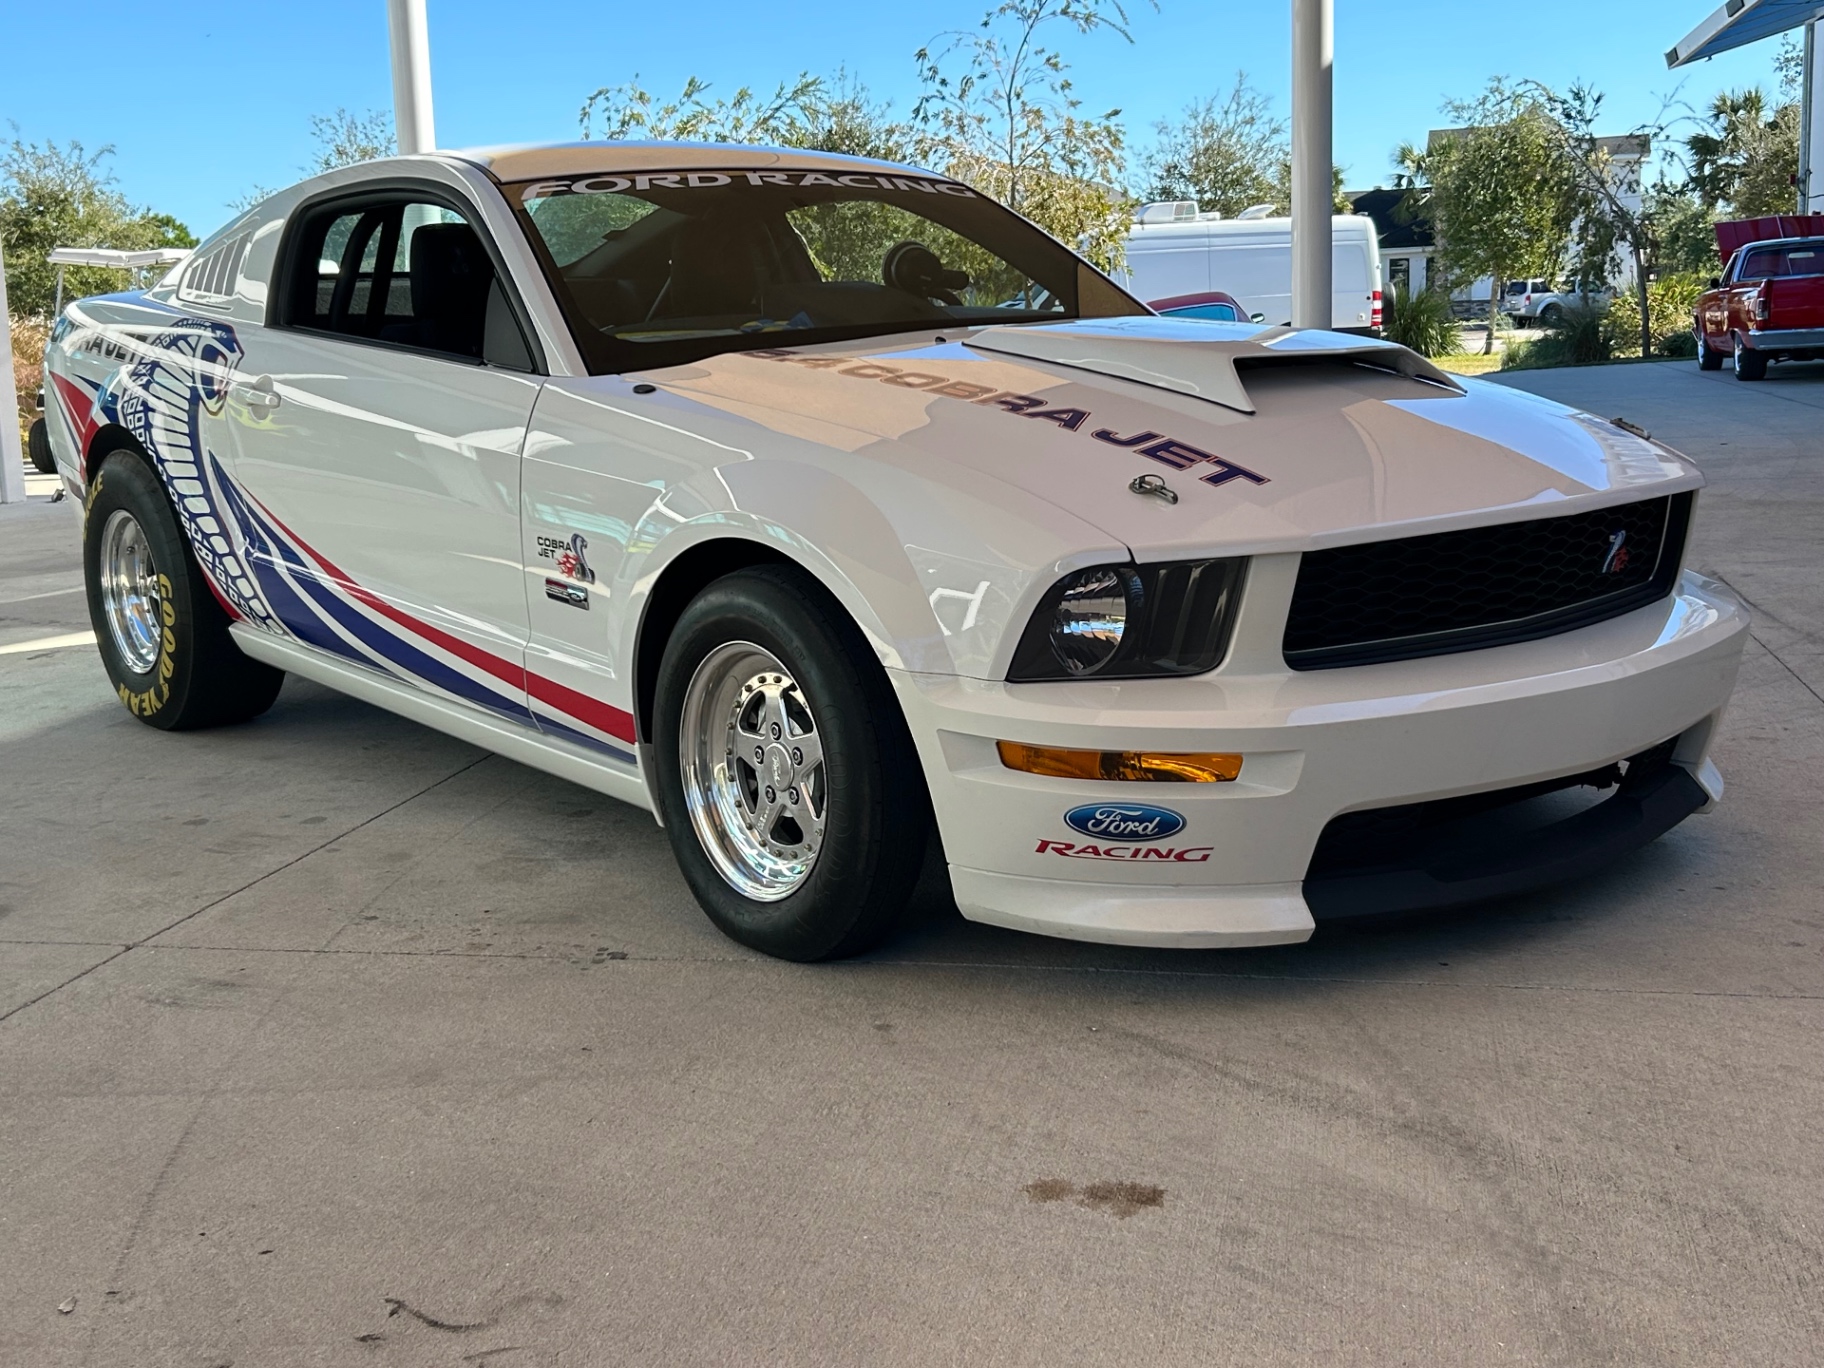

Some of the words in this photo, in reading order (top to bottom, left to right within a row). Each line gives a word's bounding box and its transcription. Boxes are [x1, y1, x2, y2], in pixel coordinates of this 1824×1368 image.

[520, 172, 732, 202] FORD
[747, 171, 978, 199] RACING
[837, 363, 1093, 433] COBRA
[1091, 428, 1272, 487] JET
[537, 536, 573, 553] COBRA
[538, 548, 556, 559] JET
[1087, 807, 1160, 836] Ford
[1035, 839, 1215, 863] RACING
